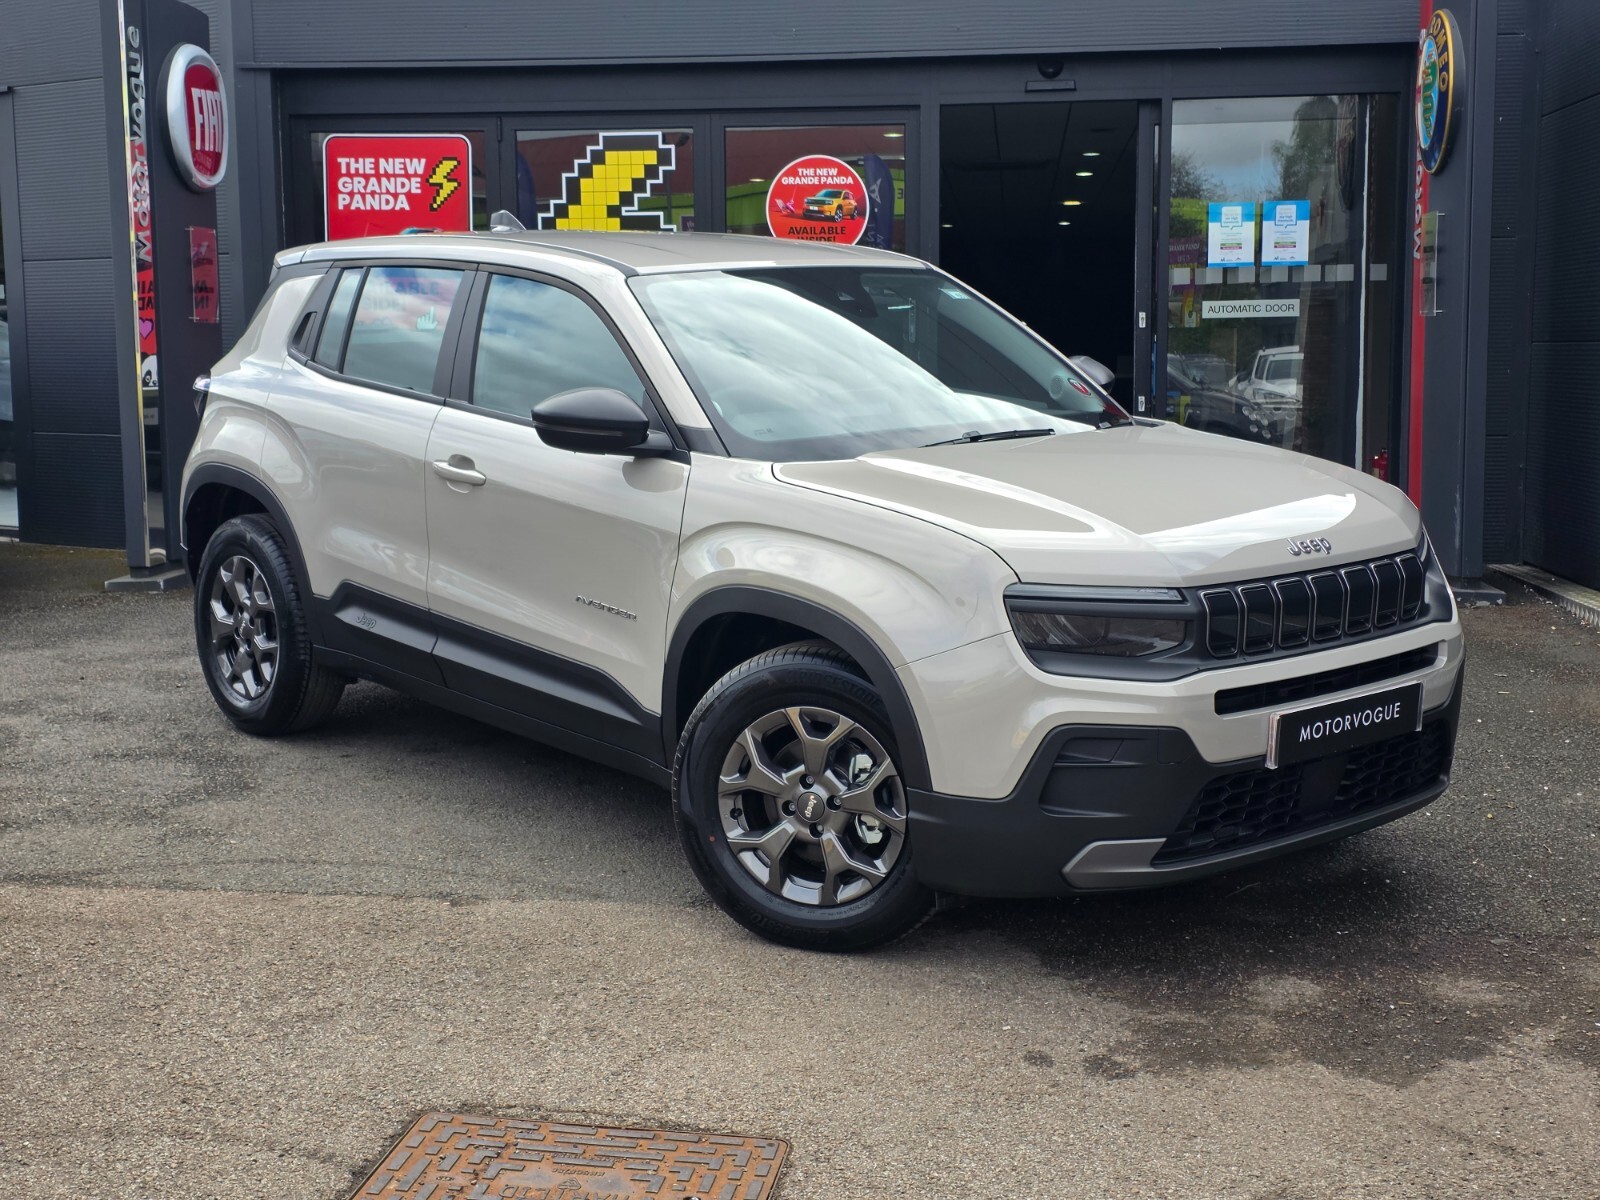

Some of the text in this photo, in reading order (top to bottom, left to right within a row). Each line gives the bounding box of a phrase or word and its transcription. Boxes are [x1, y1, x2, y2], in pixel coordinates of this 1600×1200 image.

[191, 87, 222, 153] FIAT
[337, 157, 426, 174] THE NEW
[797, 168, 838, 176] THE NEW
[337, 176, 421, 193] GRANDE
[781, 176, 854, 185] GRANDE PANDA
[338, 194, 410, 210] PANDA
[788, 226, 847, 235] AVAILABLE
[1207, 303, 1295, 314] AUTOMATIC DOOR
[1287, 536, 1332, 555] Jeep
[355, 612, 377, 630] Jeep
[1299, 702, 1401, 742] MOTORVOGUE
[804, 795, 817, 823] Jeep
